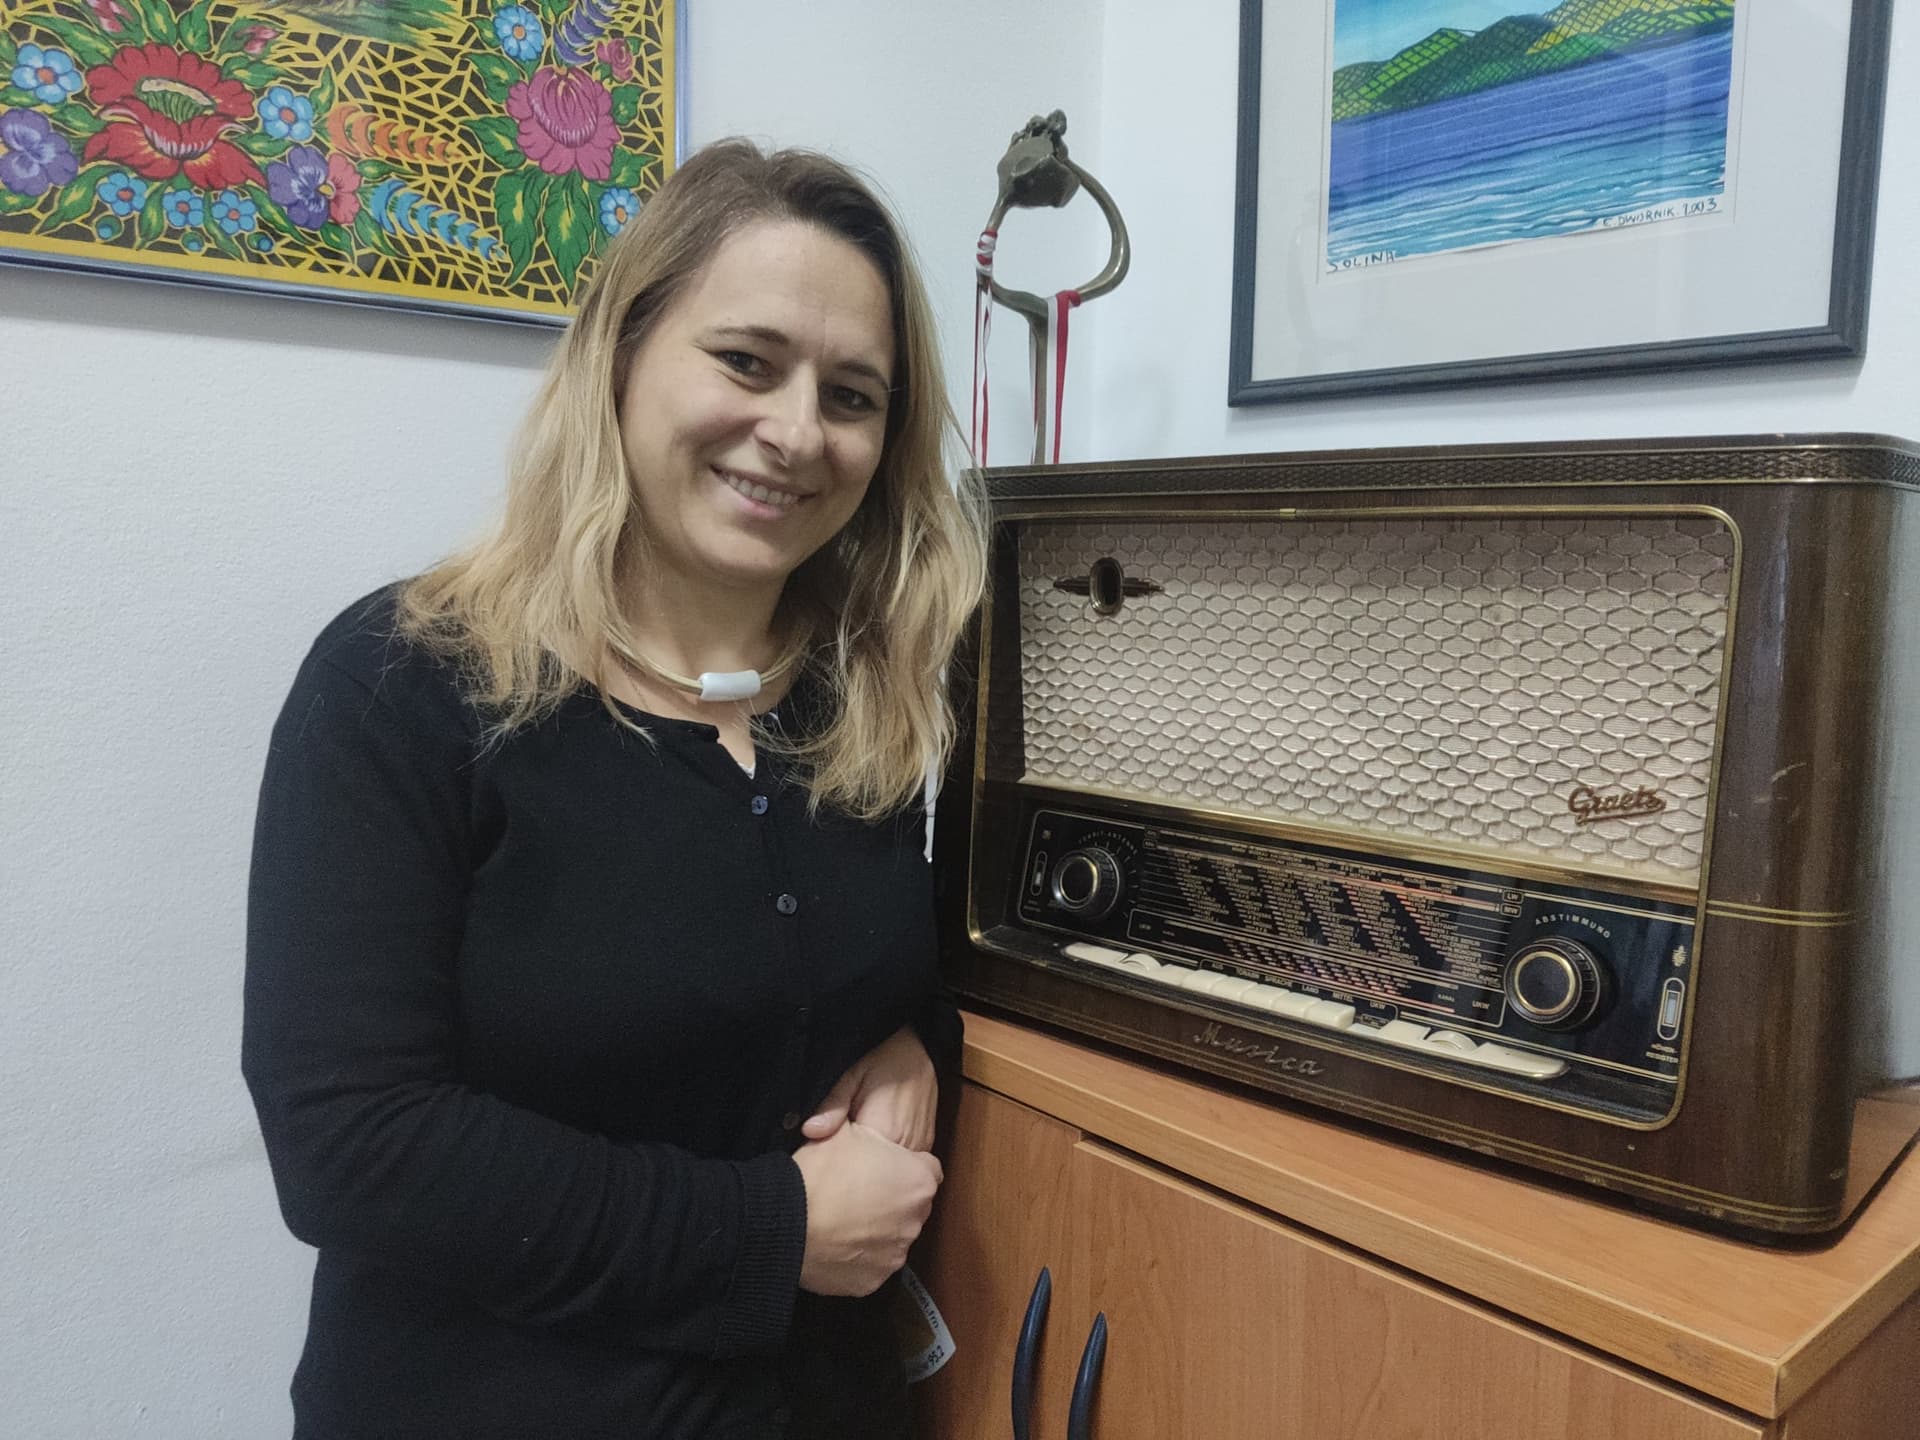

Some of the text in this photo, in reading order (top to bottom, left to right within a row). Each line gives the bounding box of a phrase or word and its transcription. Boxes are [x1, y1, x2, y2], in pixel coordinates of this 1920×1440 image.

[1568, 784, 1667, 827] Graetz
[1535, 913, 1612, 939] ABSTIMMUNG
[1192, 1021, 1327, 1076] Musica
